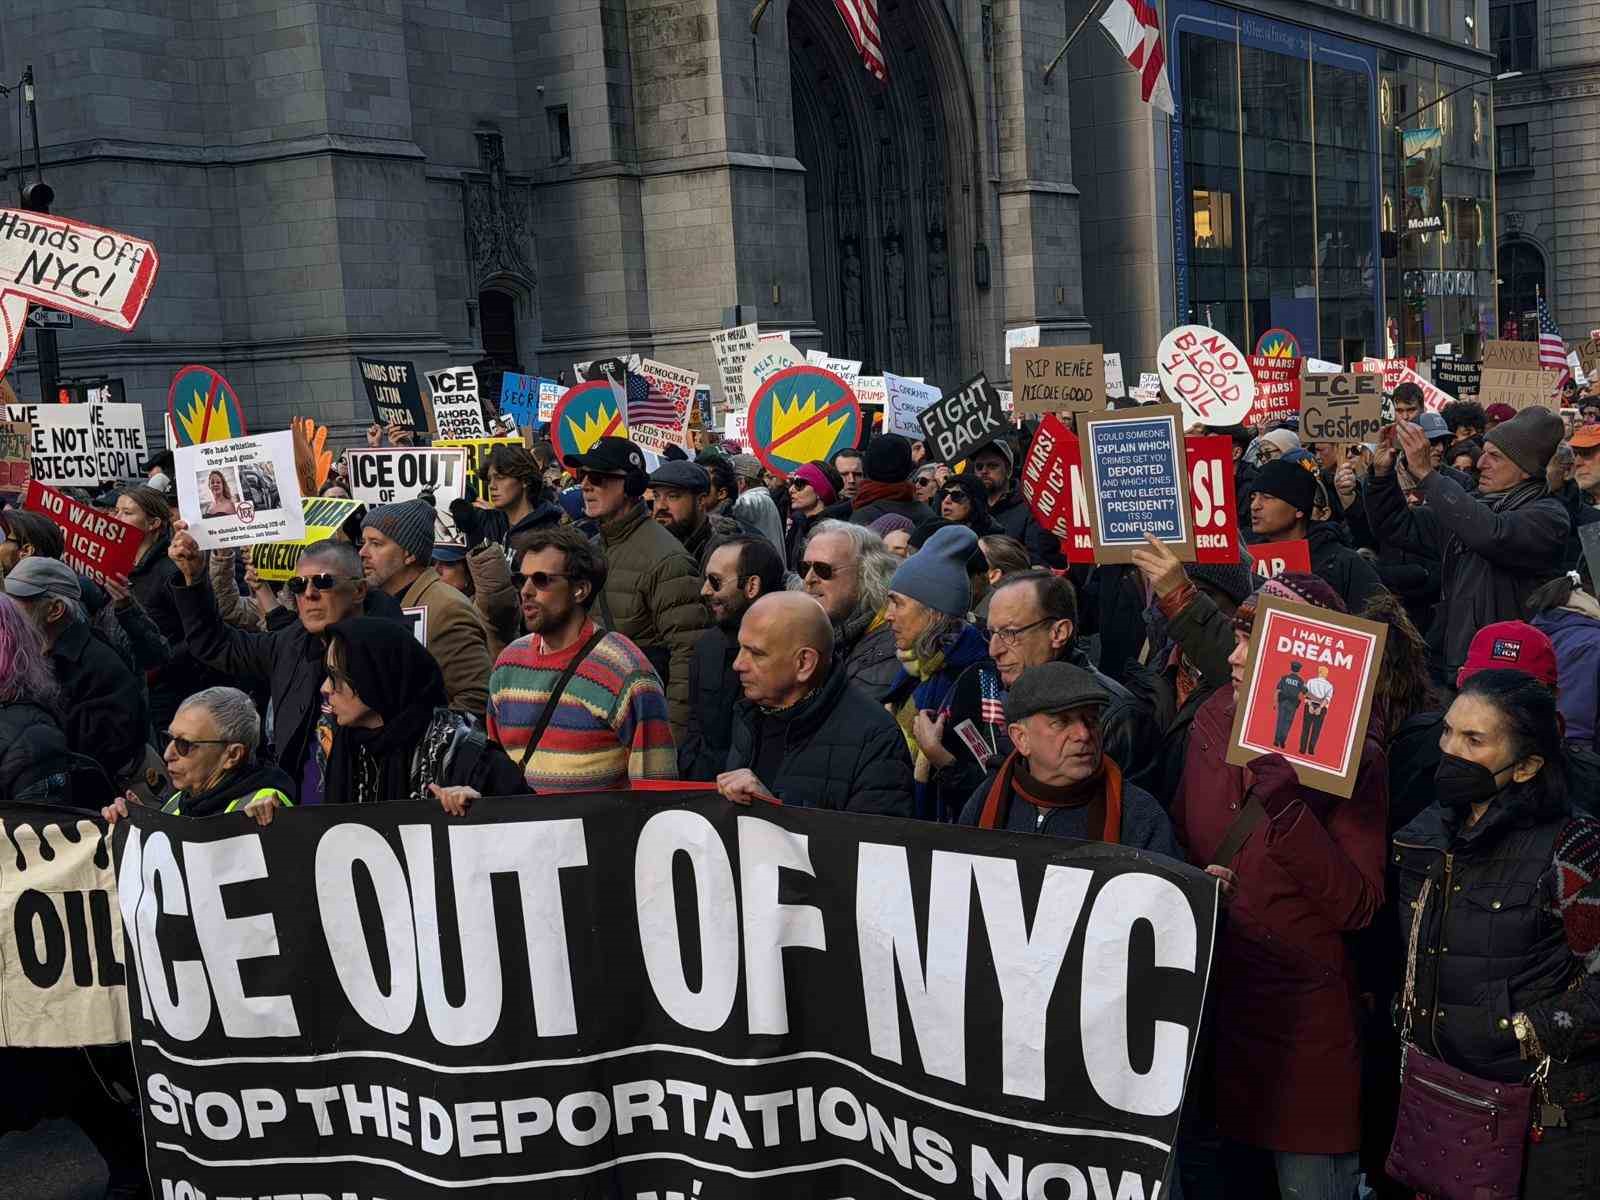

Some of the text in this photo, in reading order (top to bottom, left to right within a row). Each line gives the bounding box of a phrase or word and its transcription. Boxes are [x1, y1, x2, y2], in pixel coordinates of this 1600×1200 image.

[1408, 216, 1441, 229] MoMA
[0, 212, 144, 274] Hands Off
[14, 250, 116, 305] NYC!
[34, 309, 49, 321] ONE
[1486, 345, 1536, 363] ANYONE
[752, 354, 773, 377] MELT
[778, 355, 795, 368] ICE
[826, 363, 850, 371] NEW
[1026, 359, 1050, 377] RIP
[1175, 331, 1241, 402] BLOOD
[1253, 358, 1295, 368] NO WARS!
[1362, 360, 1408, 372] NO WARS!
[1441, 363, 1452, 371] NO
[1454, 363, 1475, 371] MORE
[362, 362, 408, 383] HANDS OFF
[643, 364, 697, 386] DEMOCRACY
[1258, 370, 1288, 380] NO ICE!
[1439, 373, 1467, 383] CRIMES
[429, 371, 476, 393] ICE
[858, 379, 883, 388] FUCK
[1166, 353, 1217, 418] 4 OIL
[1262, 382, 1293, 395] WARS!
[374, 386, 402, 404] LATIN
[433, 394, 477, 405] FUERA
[856, 390, 886, 400] TRUMP
[1022, 384, 1060, 401] NICOLE
[1062, 385, 1093, 401] GOOD
[923, 377, 989, 436] FIGHT
[1254, 396, 1289, 410] NO ICE!
[437, 409, 479, 418] AHORA
[1249, 414, 1262, 424] NO
[438, 418, 481, 427] AHORA
[1304, 407, 1380, 442] Gestapo
[52, 428, 88, 453] NOT
[114, 428, 144, 450] THE
[440, 427, 482, 437] AHORA
[632, 432, 669, 449] COURA
[660, 431, 683, 444] YOUR
[937, 405, 1000, 461] BACK
[1098, 428, 1166, 441] COULD SOMEONE
[1097, 440, 1170, 455] EXPLAIN WHICH
[99, 453, 149, 479] EOPLE
[1023, 428, 1057, 503] NO WARS!
[1101, 453, 1167, 465] CRIMES GET YOU
[352, 454, 395, 489] ICE
[398, 453, 462, 489] OUT
[1108, 464, 1164, 477] DEPORTED
[1102, 475, 1171, 487] AND WHICH ONES
[379, 489, 395, 502] OF
[1101, 486, 1176, 499] GET YOU ELECTED
[1037, 486, 1053, 517] NO
[1107, 500, 1175, 513] PRESIDENT?
[41, 491, 63, 515] NO
[69, 503, 127, 545] WARS!
[1141, 511, 1153, 520] SO
[1110, 520, 1174, 533] CONFUSING
[72, 533, 107, 563] ICE!
[252, 543, 305, 571] VENEZU
[1292, 627, 1344, 650] I HAVE A
[1277, 636, 1354, 670] DREAM
[14, 887, 125, 988] OIL
[118, 809, 1197, 1116] ICE OUT OF NYC
[147, 1072, 1162, 1200] STOP THE DEPORTATIONS NOW
